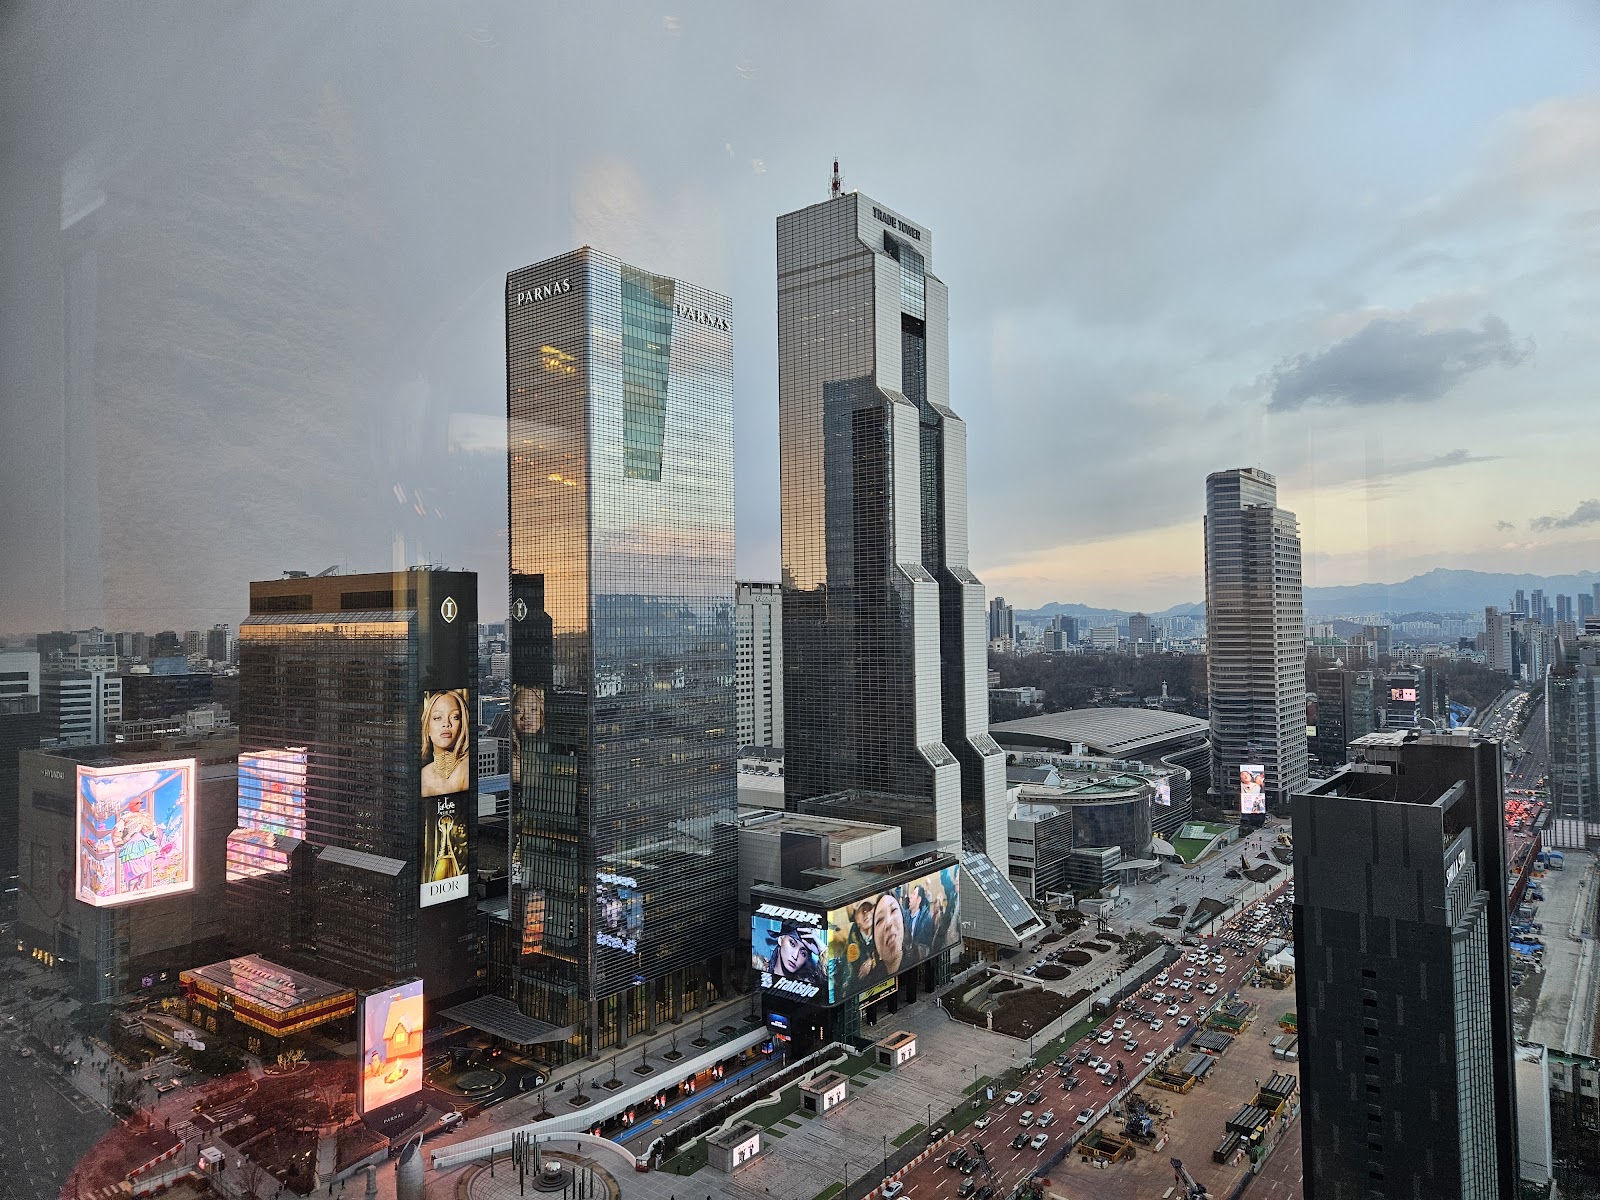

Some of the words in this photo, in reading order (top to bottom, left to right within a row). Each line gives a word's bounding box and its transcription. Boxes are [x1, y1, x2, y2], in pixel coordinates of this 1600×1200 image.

[872, 206, 897, 229] TRADE
[897, 219, 921, 241] TOWER
[517, 278, 570, 305] PARNAS
[676, 303, 731, 331] PARNAS
[430, 880, 460, 897] DIOR
[383, 1111, 404, 1124] PARNAS
